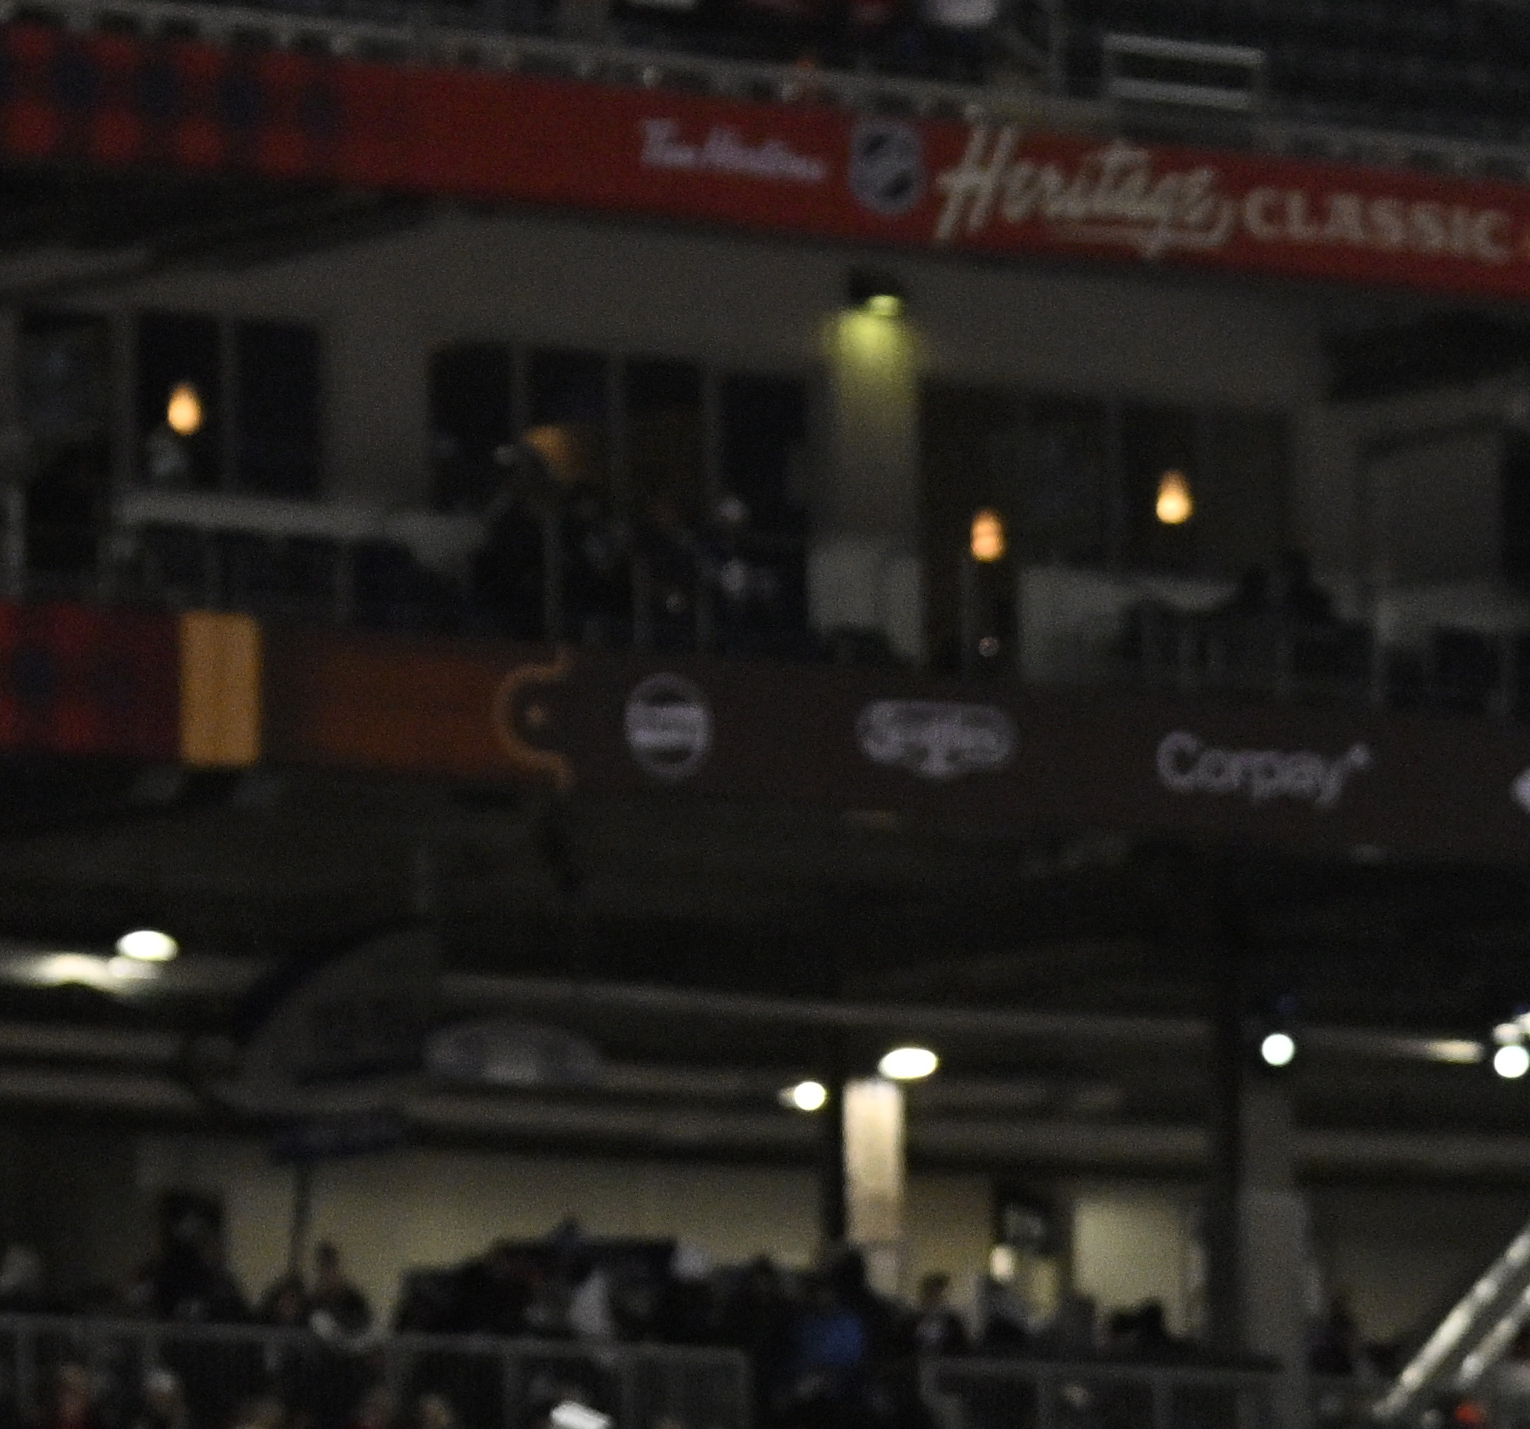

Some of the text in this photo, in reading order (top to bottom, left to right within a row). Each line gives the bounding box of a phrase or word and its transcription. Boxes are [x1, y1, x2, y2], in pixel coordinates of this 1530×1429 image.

[932, 120, 1238, 262] Heritage
[1242, 184, 1512, 266] CLASSIC
[1155, 730, 1356, 810] Corpay
